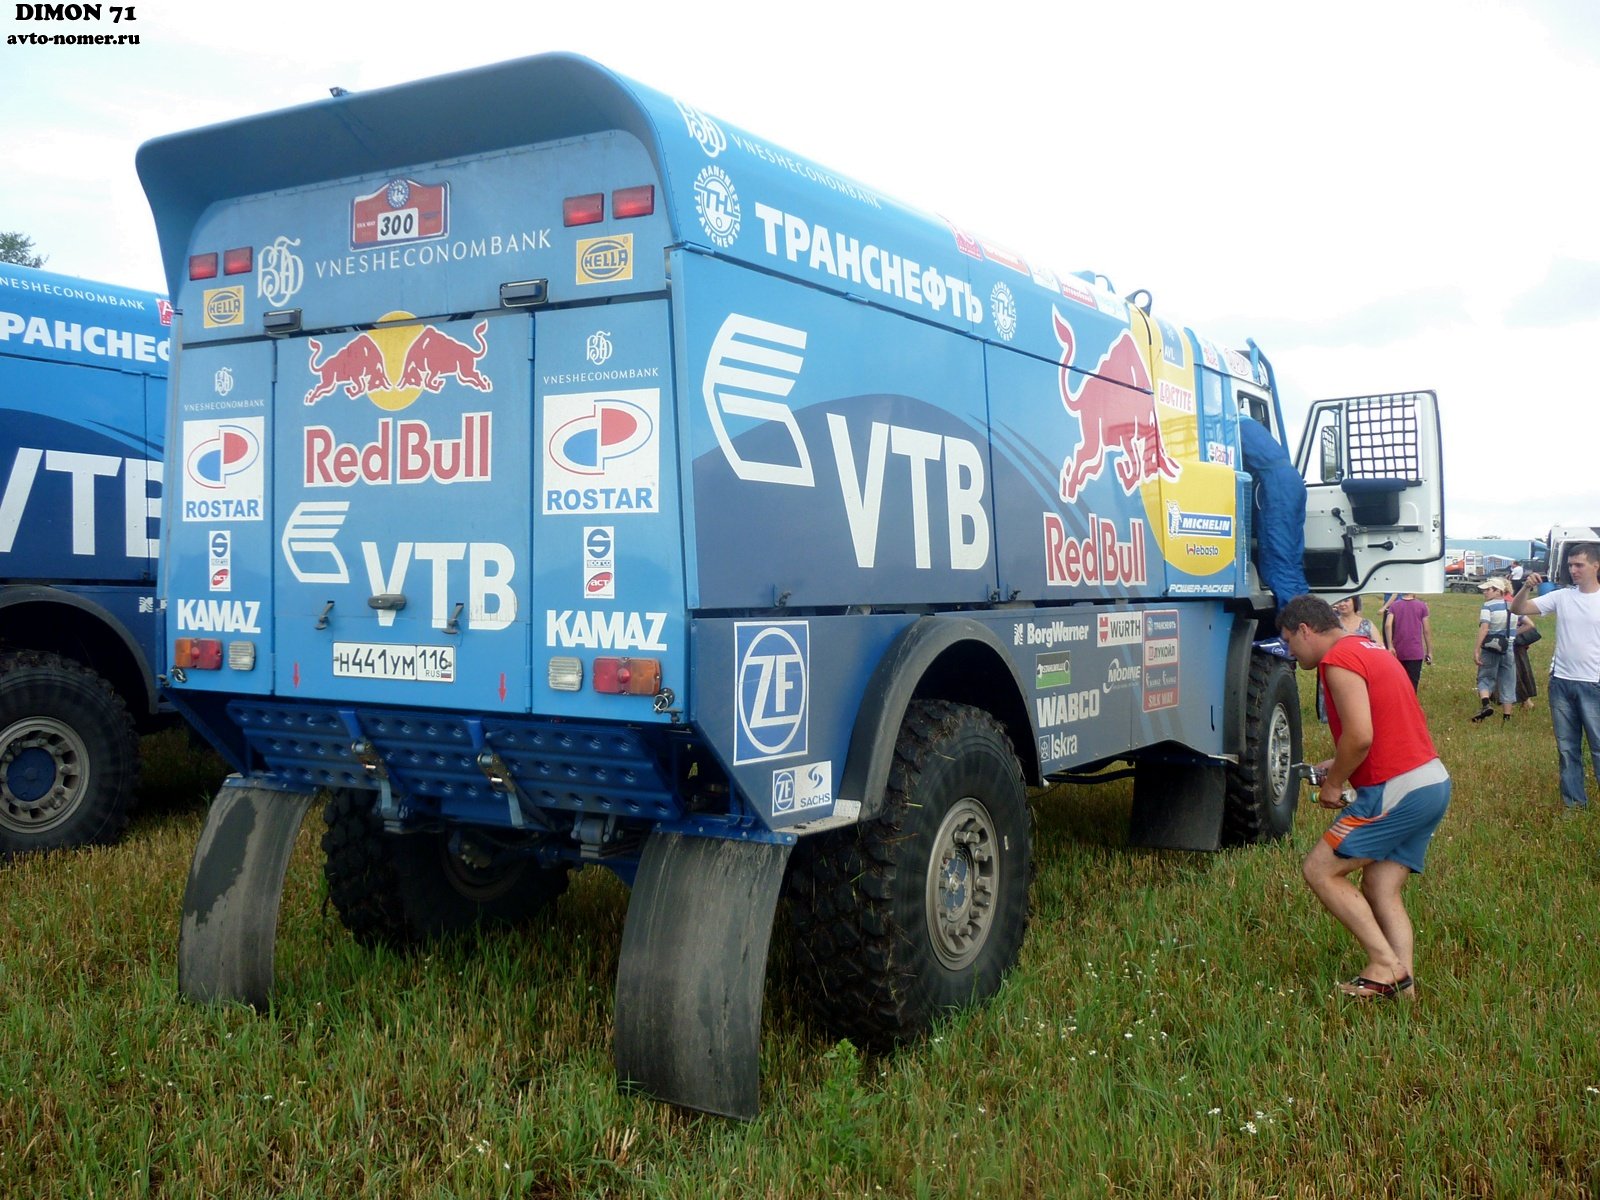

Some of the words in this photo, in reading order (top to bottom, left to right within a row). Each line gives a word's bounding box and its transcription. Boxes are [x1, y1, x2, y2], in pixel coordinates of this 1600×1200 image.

[380, 213, 414, 236] 300
[315, 228, 551, 278] VNESHECONOMBANK
[584, 248, 629, 269] HELLA
[754, 201, 983, 325] ТРАНСНЕФТЬ
[209, 298, 241, 314] HELLA
[543, 367, 659, 385] VNESHECONOMBANK
[184, 399, 265, 412] VNESHECONOMBANK
[304, 418, 393, 487] Red
[396, 411, 492, 484] Bull
[546, 487, 653, 511] ROSTAR
[826, 412, 990, 570] VTB
[185, 499, 259, 518] ROSTAR
[1182, 518, 1230, 532] MICHELIN
[1043, 512, 1100, 586] Red
[1098, 518, 1147, 587] Bull
[361, 541, 518, 630] VTB
[177, 599, 261, 633] KAMAZ
[546, 609, 668, 651] KAMAZ
[1026, 620, 1090, 648] BorgWarner
[1107, 664, 1142, 683] MODINE
[746, 653, 801, 729] ZF
[1036, 688, 1100, 728] WABCO
[1051, 732, 1078, 760] Iskra
[800, 792, 831, 808] SACHS
